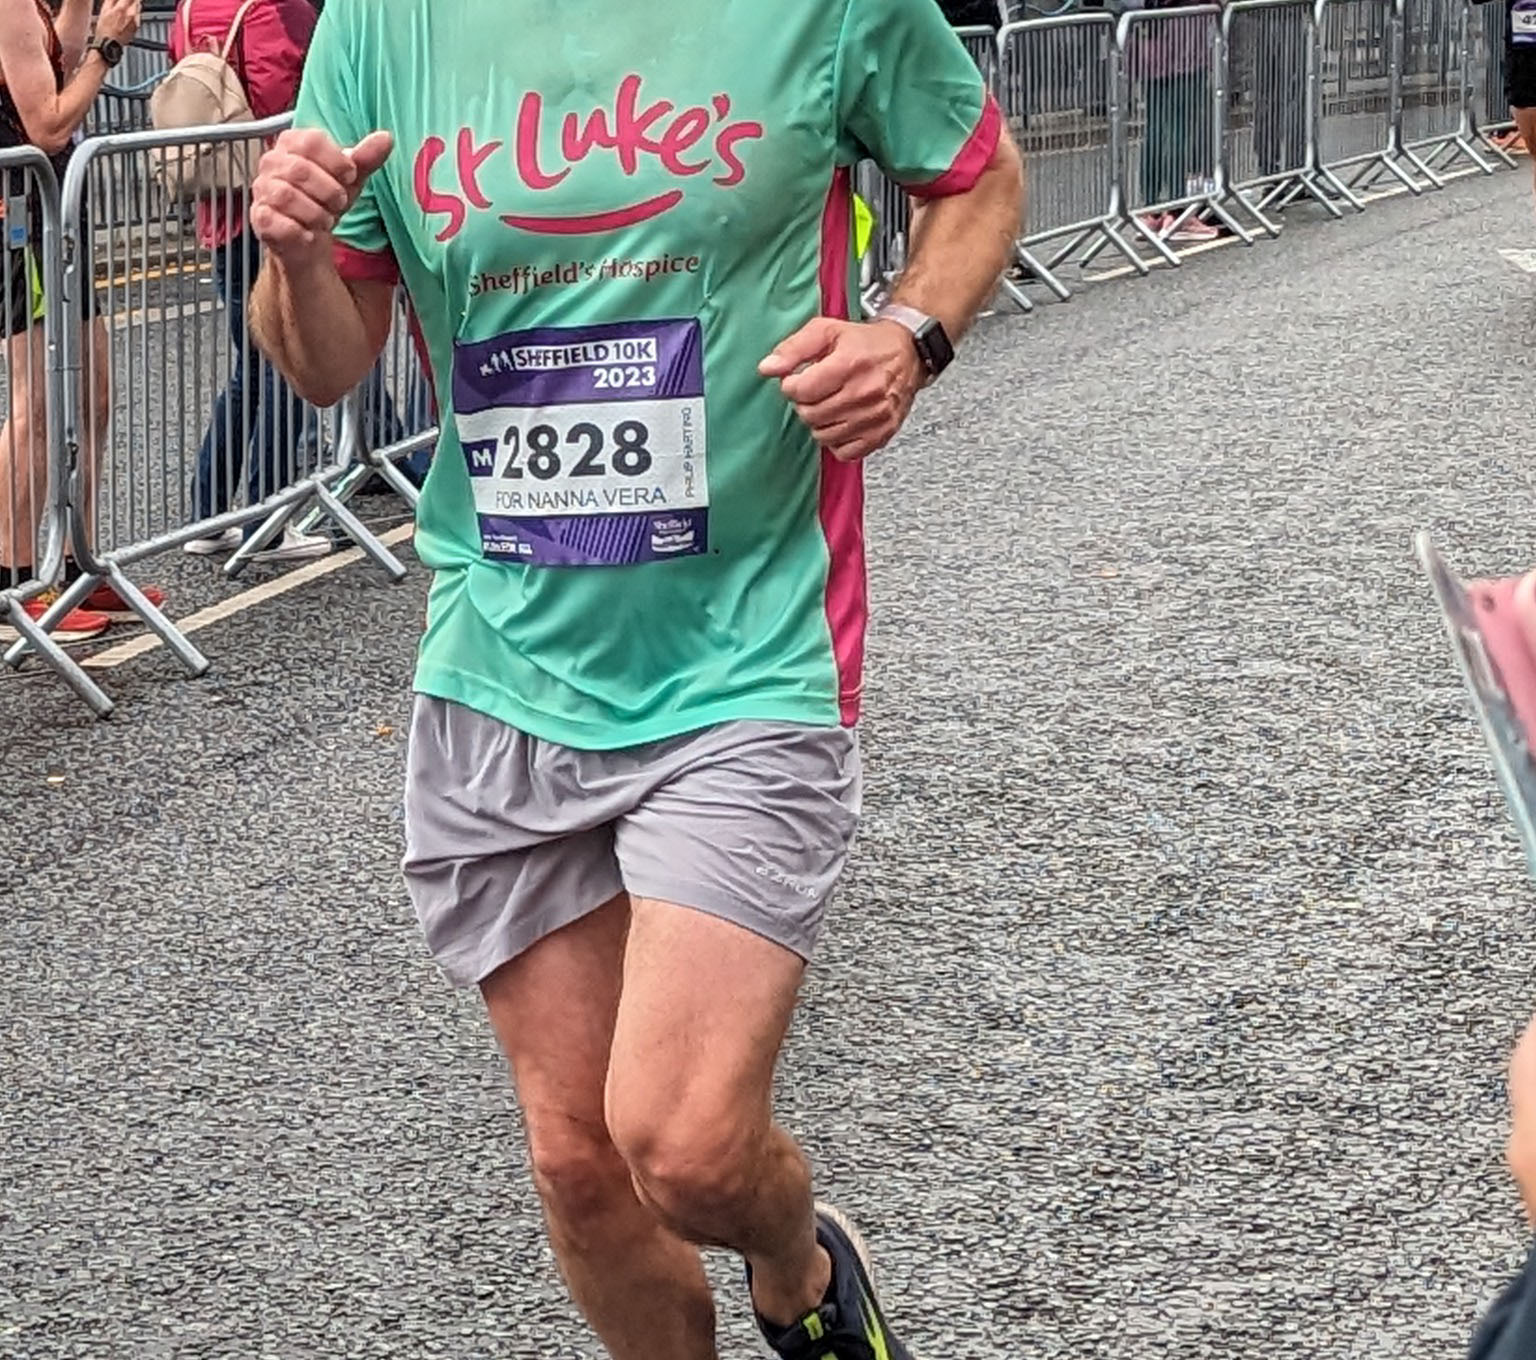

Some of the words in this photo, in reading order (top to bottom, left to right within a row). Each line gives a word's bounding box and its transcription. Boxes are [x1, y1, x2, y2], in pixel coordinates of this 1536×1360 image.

[516, 73, 763, 190] Luke's
[468, 261, 592, 298] Sheffield's
[599, 253, 699, 282] Hospice
[515, 344, 609, 368] SHEFFIELD
[614, 340, 653, 360] 10K
[593, 366, 656, 389] 2023
[472, 448, 492, 469] M
[501, 420, 653, 480] 2828
[496, 490, 524, 509] FOR
[528, 489, 599, 509] NANNA
[603, 487, 666, 506] VERA
